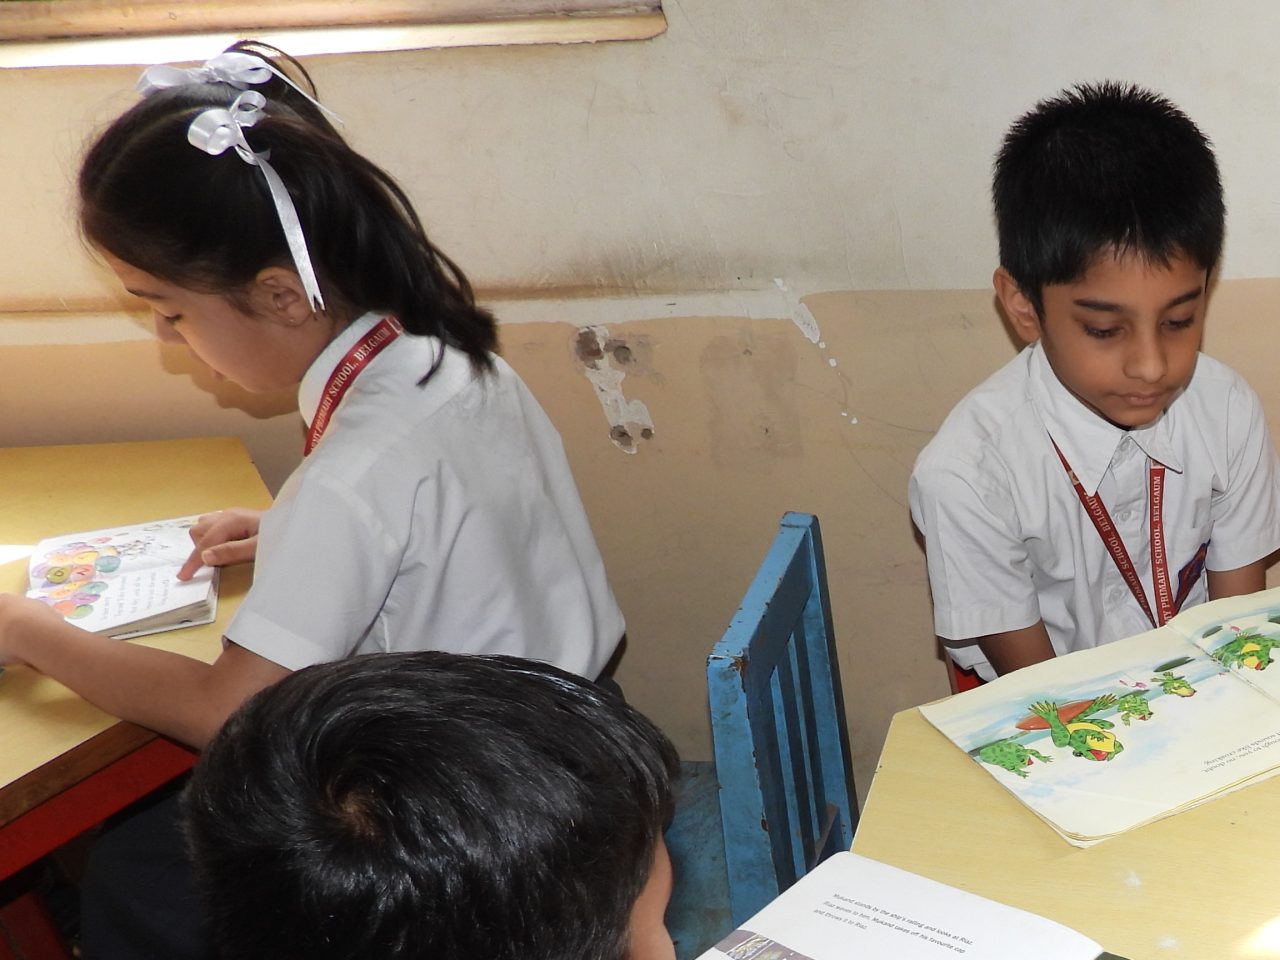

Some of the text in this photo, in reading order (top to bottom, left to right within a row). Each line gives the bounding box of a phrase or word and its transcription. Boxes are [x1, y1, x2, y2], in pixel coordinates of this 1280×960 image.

[317, 395, 333, 434] PRIMARY
[353, 327, 391, 362] BELGAUM
[1153, 475, 1161, 522] BELGAUM
[1156, 566, 1172, 611] PRIMARY
[1237, 744, 1252, 752] like
[1251, 734, 1276, 747] sounds
[824, 912, 843, 921] throws
[835, 905, 852, 914] waves
[871, 917, 895, 928] Mukand
[894, 925, 911, 934] takes
[928, 937, 954, 949] favourite
[953, 946, 966, 954] cap
[854, 901, 872, 909] stands
[889, 913, 906, 922] ship's
[906, 919, 925, 928] railing
[936, 928, 952, 937] looks
